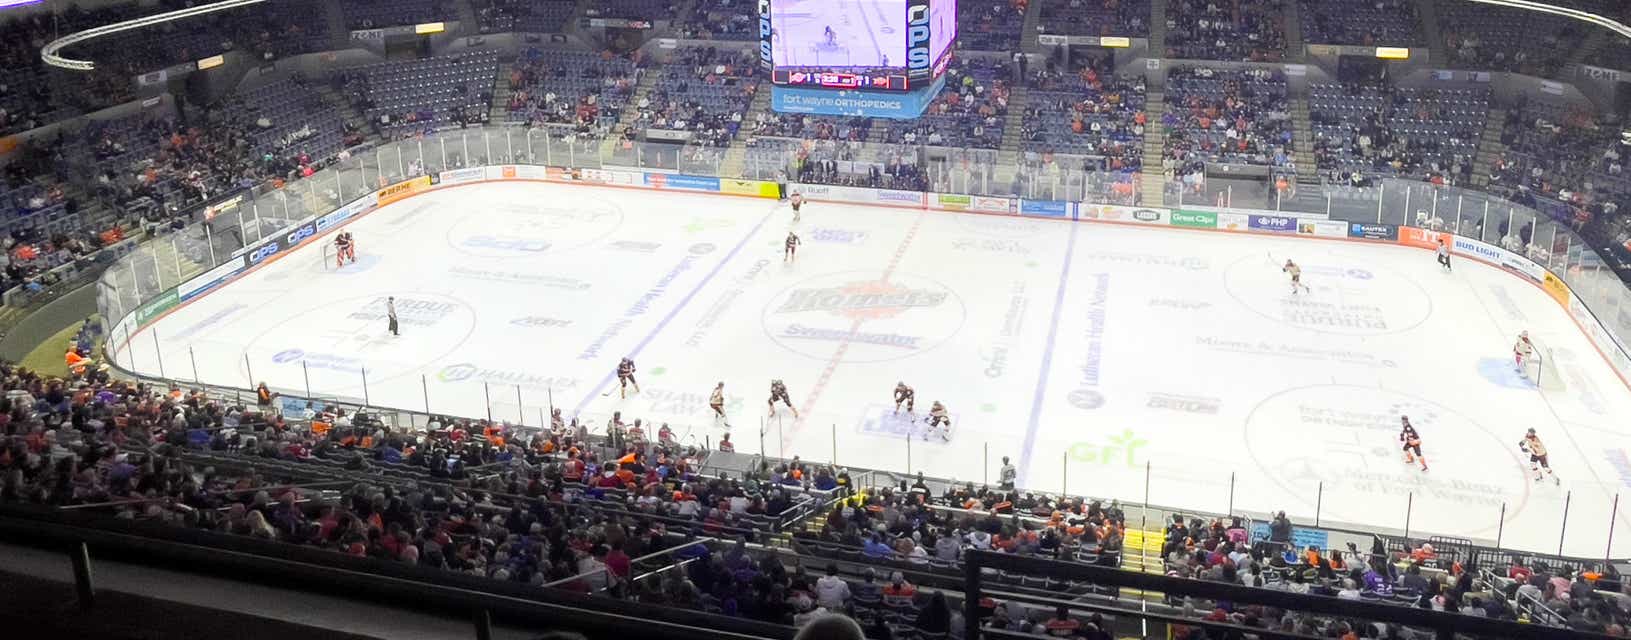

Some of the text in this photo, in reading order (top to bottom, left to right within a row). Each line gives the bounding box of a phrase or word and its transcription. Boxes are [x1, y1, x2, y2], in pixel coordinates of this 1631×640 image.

[908, 4, 931, 75] OPS
[783, 94, 901, 111] fort wayne ORTHOPEDICS
[1172, 213, 1193, 222] Great
[1270, 217, 1288, 226] PHP
[288, 224, 315, 245] OPS
[249, 242, 279, 265] OPS
[1455, 240, 1500, 260] BUD LIGHT
